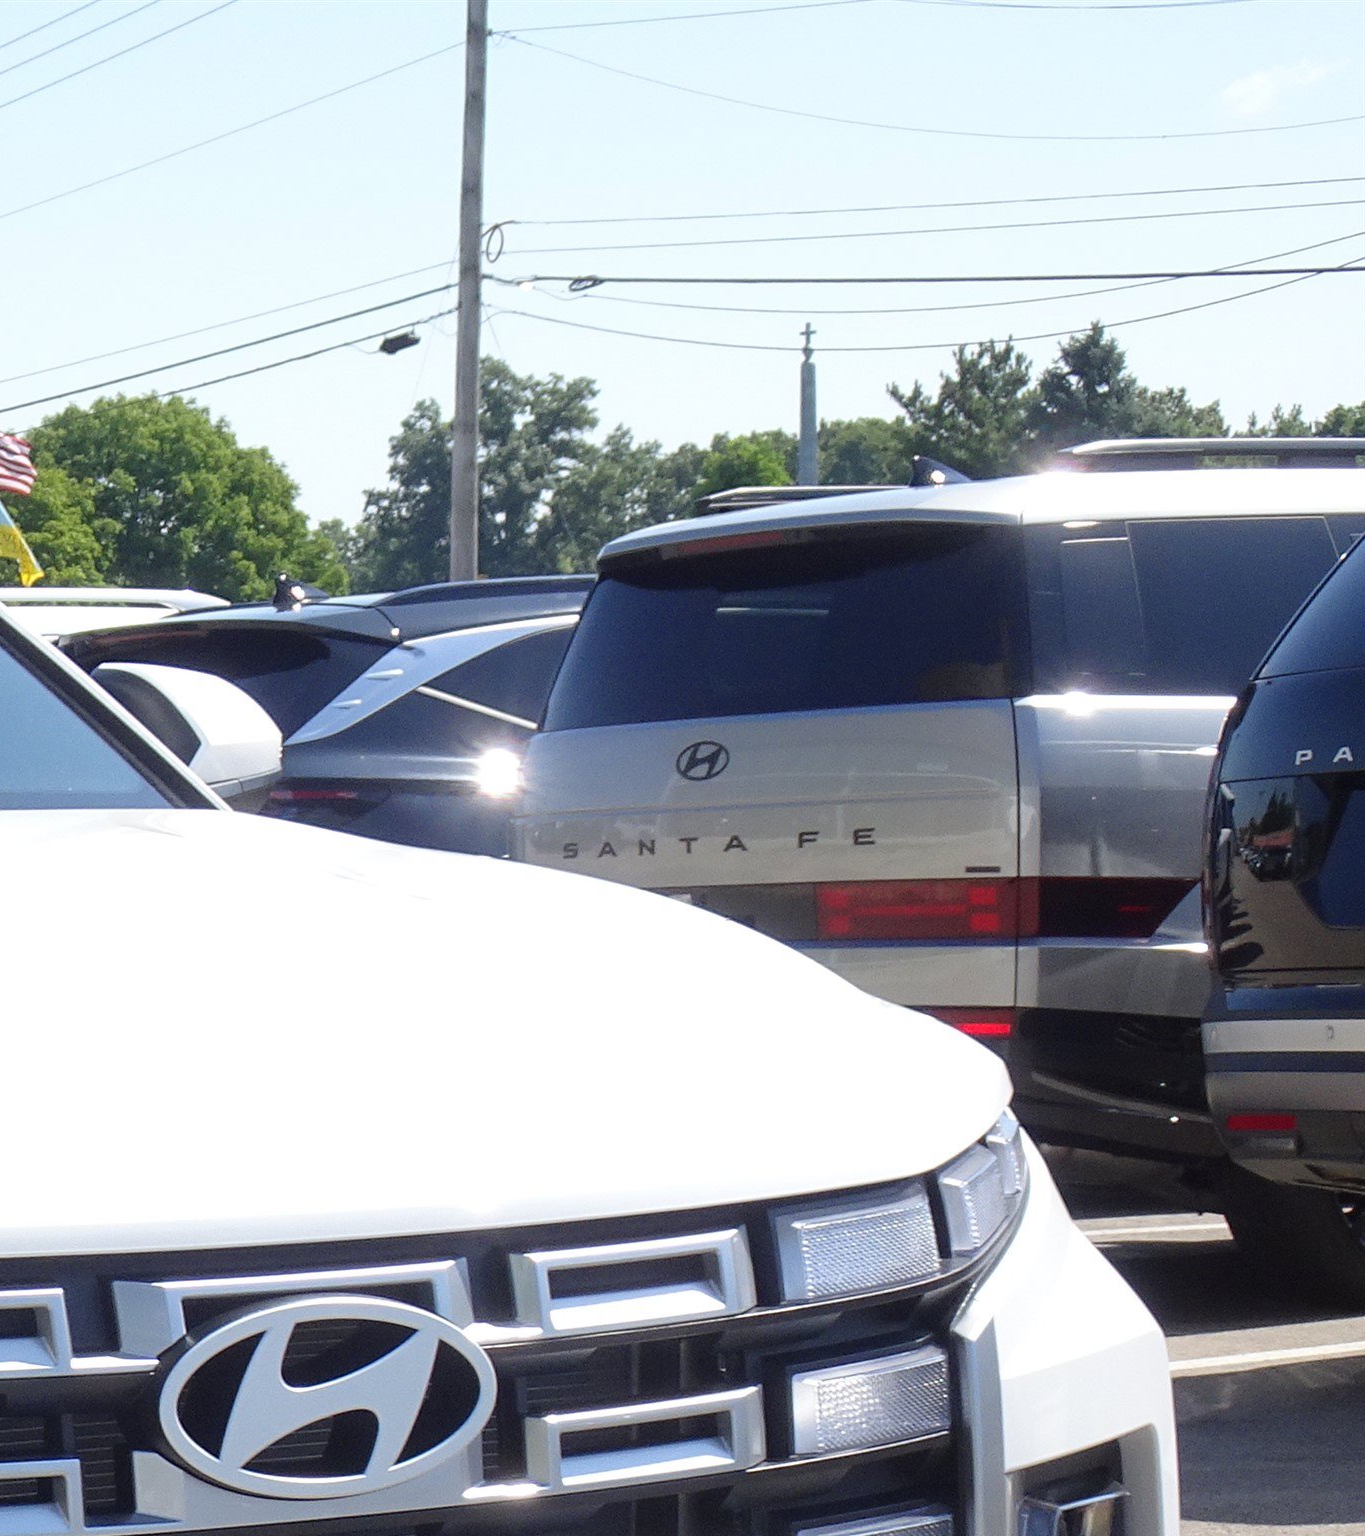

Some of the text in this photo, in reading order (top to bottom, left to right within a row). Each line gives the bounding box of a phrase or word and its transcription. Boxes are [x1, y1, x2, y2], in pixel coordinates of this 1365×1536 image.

[1295, 746, 1353, 765] PA
[563, 827, 875, 859] SANTA FE
